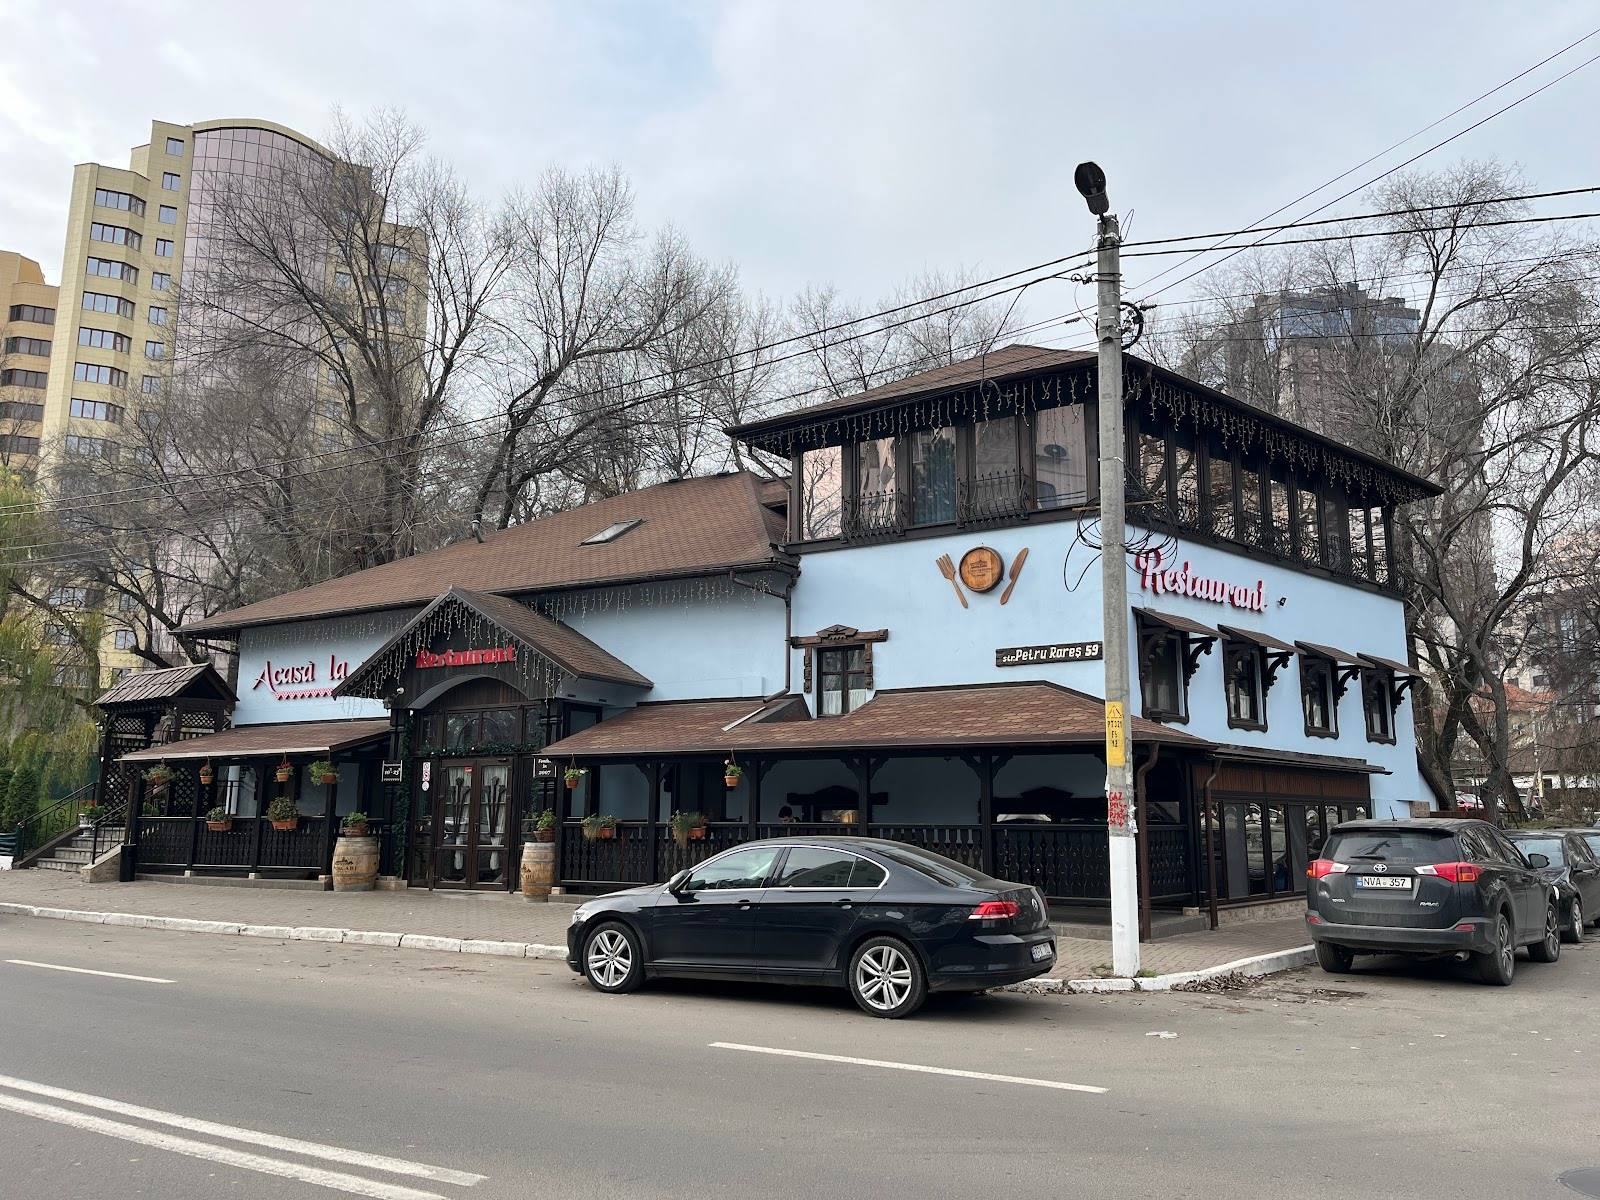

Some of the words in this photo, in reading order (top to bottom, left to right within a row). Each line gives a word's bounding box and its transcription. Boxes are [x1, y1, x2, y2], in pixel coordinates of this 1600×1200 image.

[1135, 548, 1268, 613] Restaurant
[416, 643, 516, 669] Restaurant
[1085, 644, 1099, 657] 59
[330, 654, 348, 681] la
[1364, 877, 1382, 887] NVA
[1389, 878, 1406, 888] 357
